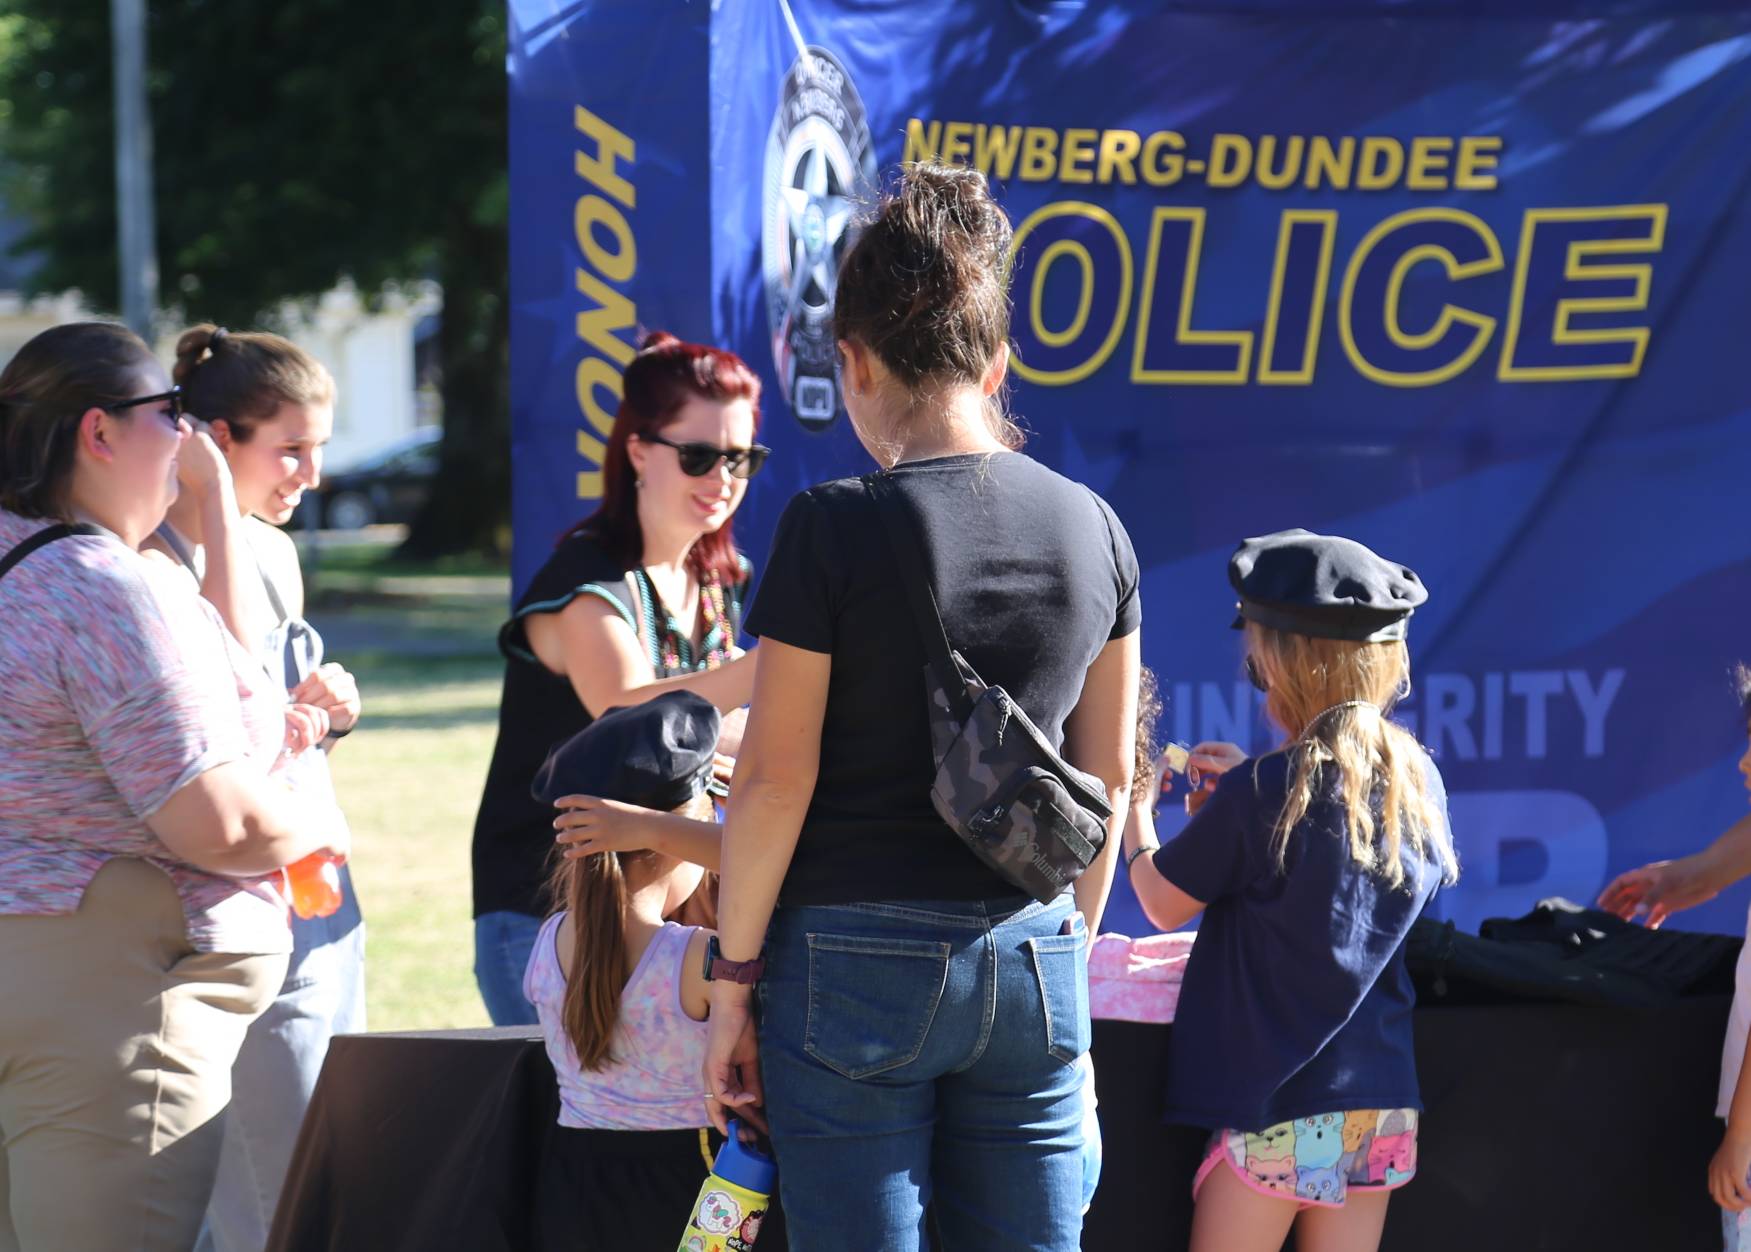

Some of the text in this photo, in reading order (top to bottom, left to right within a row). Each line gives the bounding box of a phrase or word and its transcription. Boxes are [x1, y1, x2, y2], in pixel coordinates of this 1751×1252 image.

[902, 117, 1503, 191] NEWBERG-DUNDEE
[1008, 201, 1669, 387] OLICE
[1174, 667, 1627, 763] INRITY
